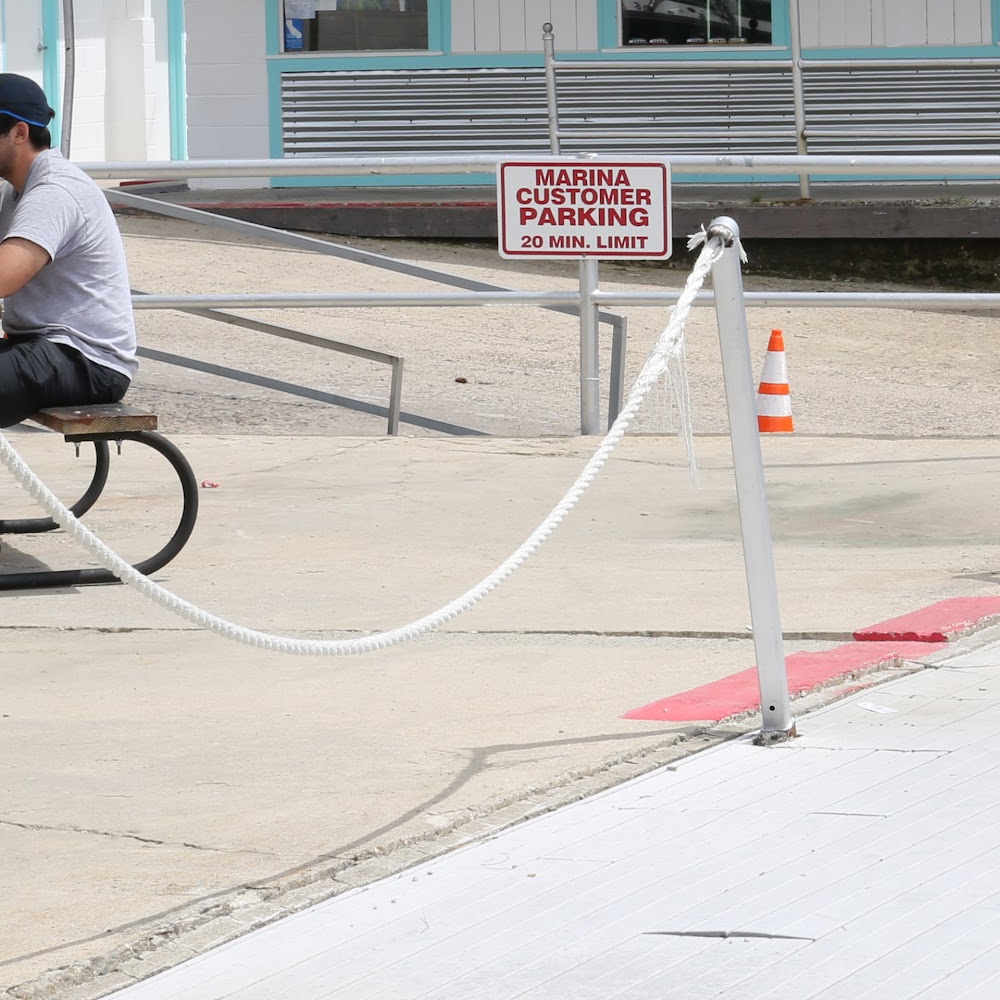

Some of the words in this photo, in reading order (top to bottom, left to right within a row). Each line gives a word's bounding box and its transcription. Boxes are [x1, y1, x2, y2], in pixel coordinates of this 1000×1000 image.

[535, 169, 631, 186] MARINA
[516, 188, 652, 205] CUSTOMER
[519, 207, 649, 226] PARKING
[521, 235, 544, 248] 20
[550, 236, 590, 248] MIN.
[597, 236, 648, 249] LIMIT
